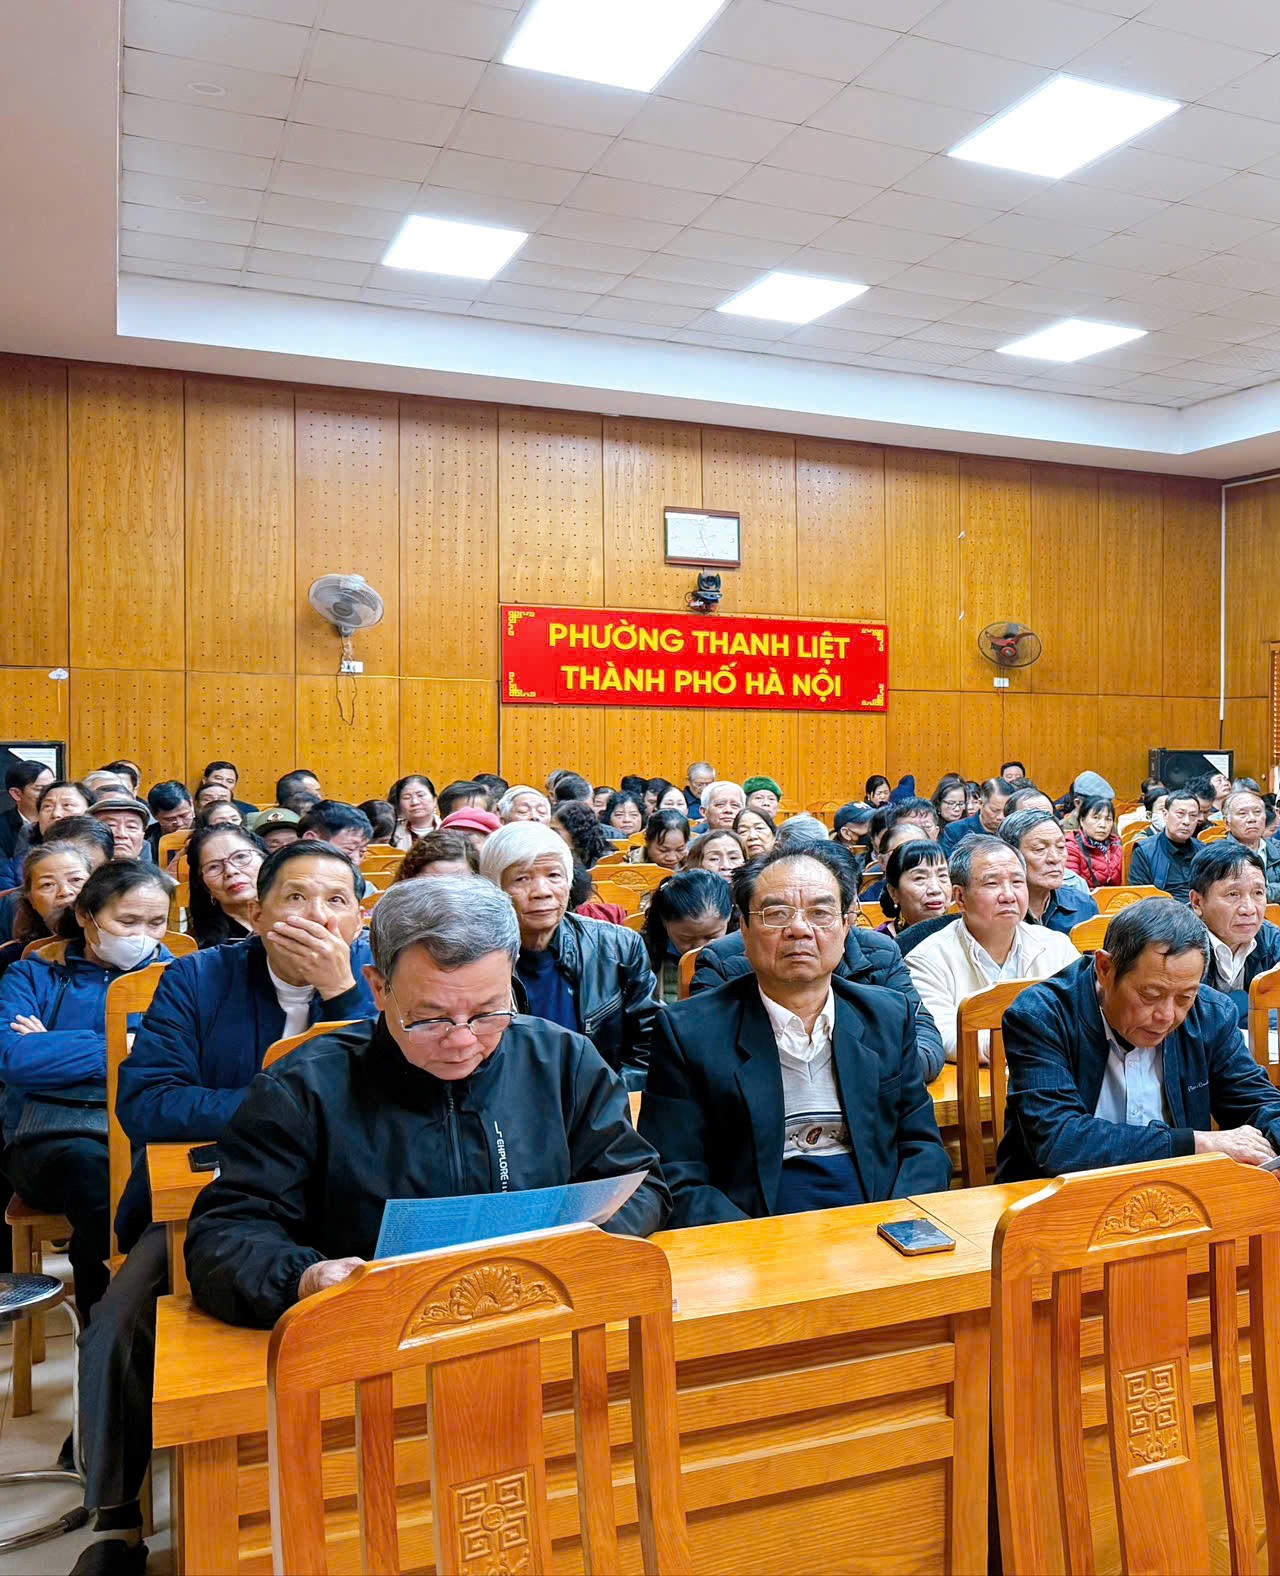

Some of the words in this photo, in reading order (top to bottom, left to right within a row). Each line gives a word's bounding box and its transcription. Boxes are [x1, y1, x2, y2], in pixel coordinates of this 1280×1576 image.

[548, 619, 685, 652] PHƯỜNG
[691, 630, 790, 657] THANH
[796, 633, 851, 665] LIỆT
[560, 661, 665, 693] THÀNH
[674, 661, 737, 695] PHỐ
[745, 667, 785, 696] HÀ
[792, 668, 842, 703] NỘI
